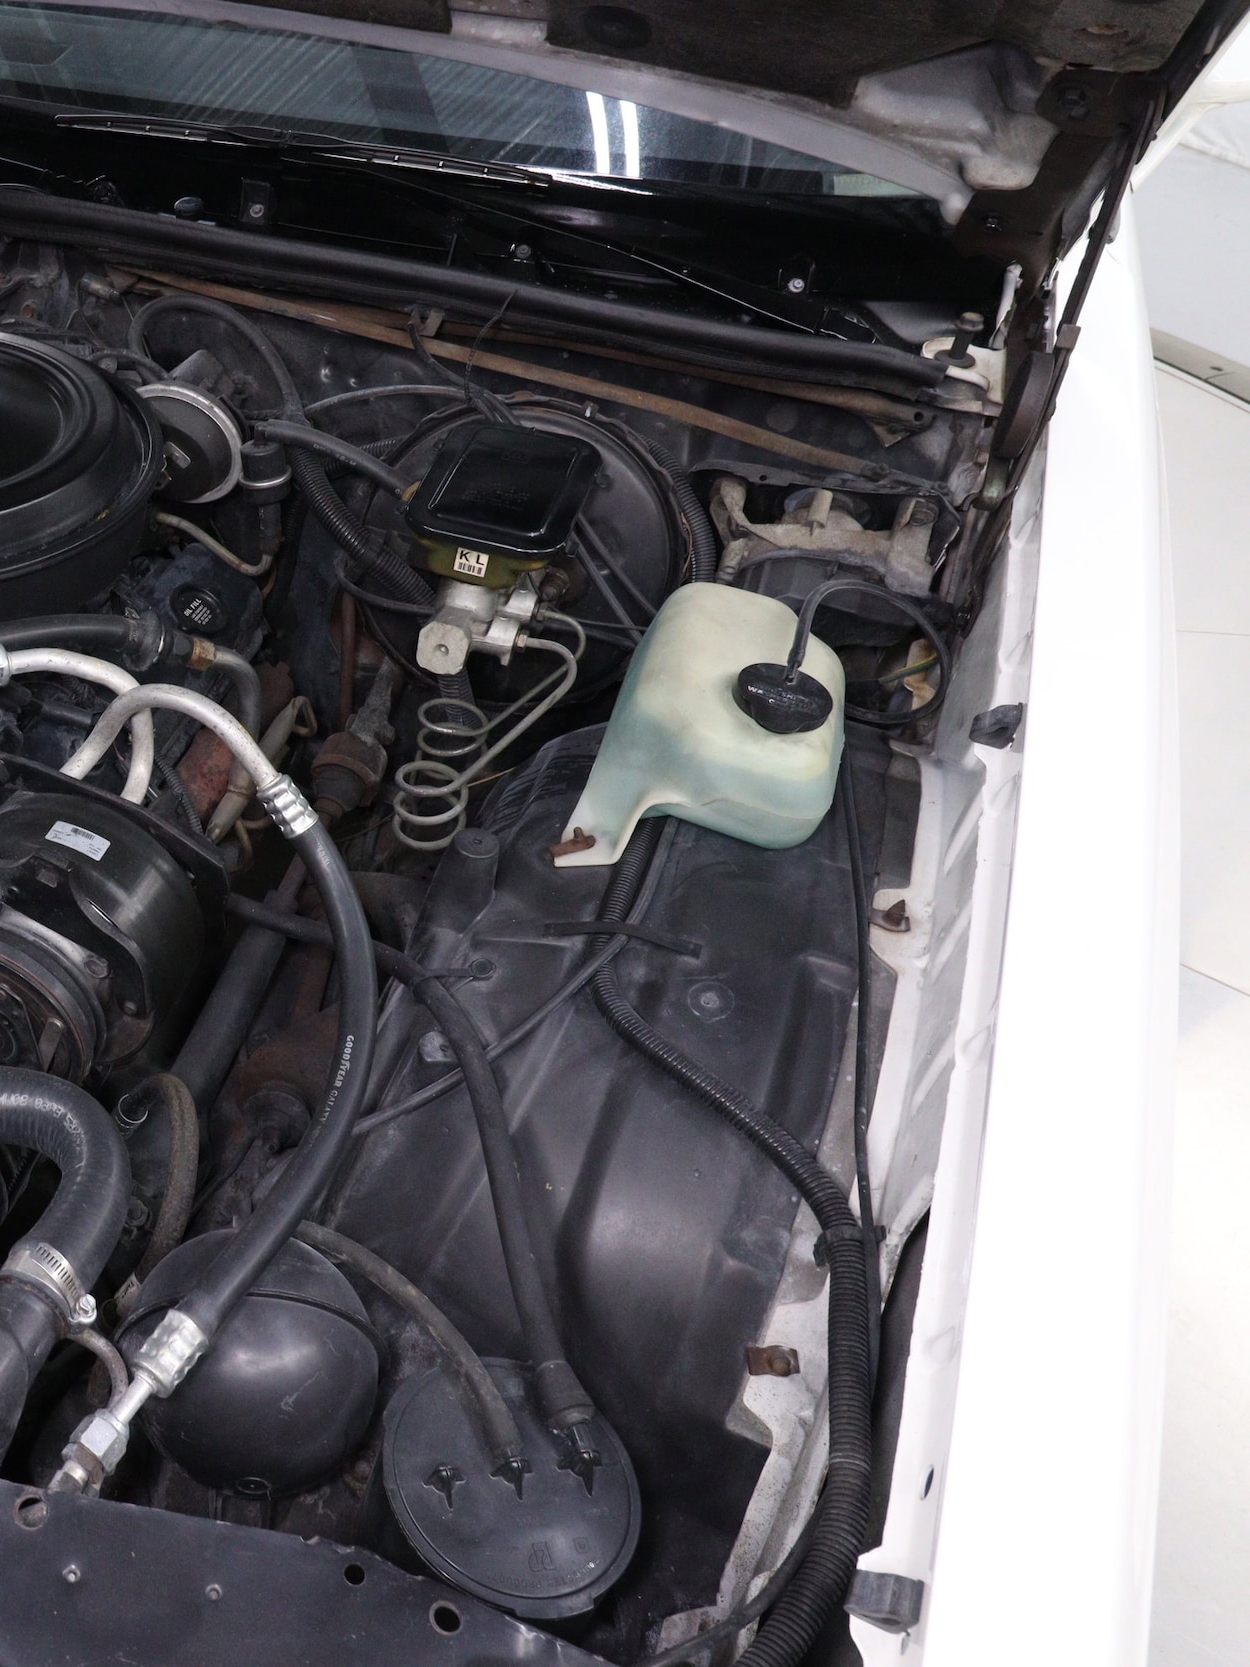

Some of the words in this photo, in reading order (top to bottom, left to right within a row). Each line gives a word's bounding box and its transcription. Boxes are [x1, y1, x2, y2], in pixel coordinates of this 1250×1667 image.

[183, 608, 193, 617] OIL
[190, 598, 202, 610] FILL
[334, 1034, 355, 1088] GOODYEAR
